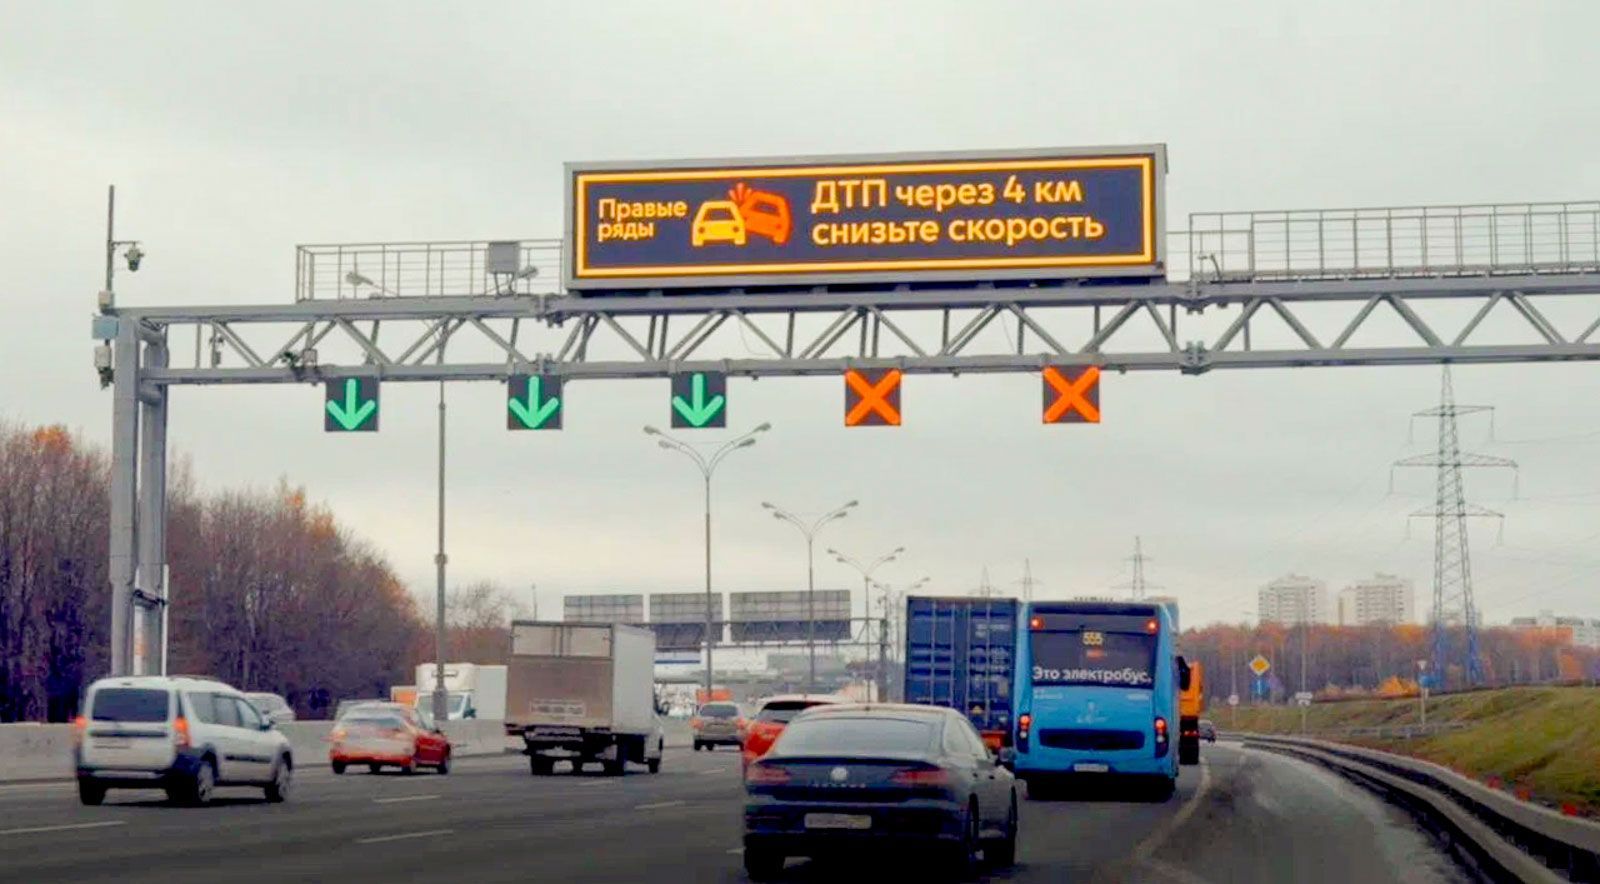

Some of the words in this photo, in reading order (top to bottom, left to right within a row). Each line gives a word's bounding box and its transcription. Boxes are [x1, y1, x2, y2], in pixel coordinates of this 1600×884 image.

[811, 179, 887, 214] ДТП
[895, 183, 995, 212] через
[1003, 174, 1026, 204] 4
[1035, 180, 1082, 203] км
[599, 199, 687, 221] Правые
[598, 221, 654, 242] ряды
[812, 220, 940, 245] снизьте
[948, 216, 1104, 246] скорость
[1032, 666, 1060, 680] Это
